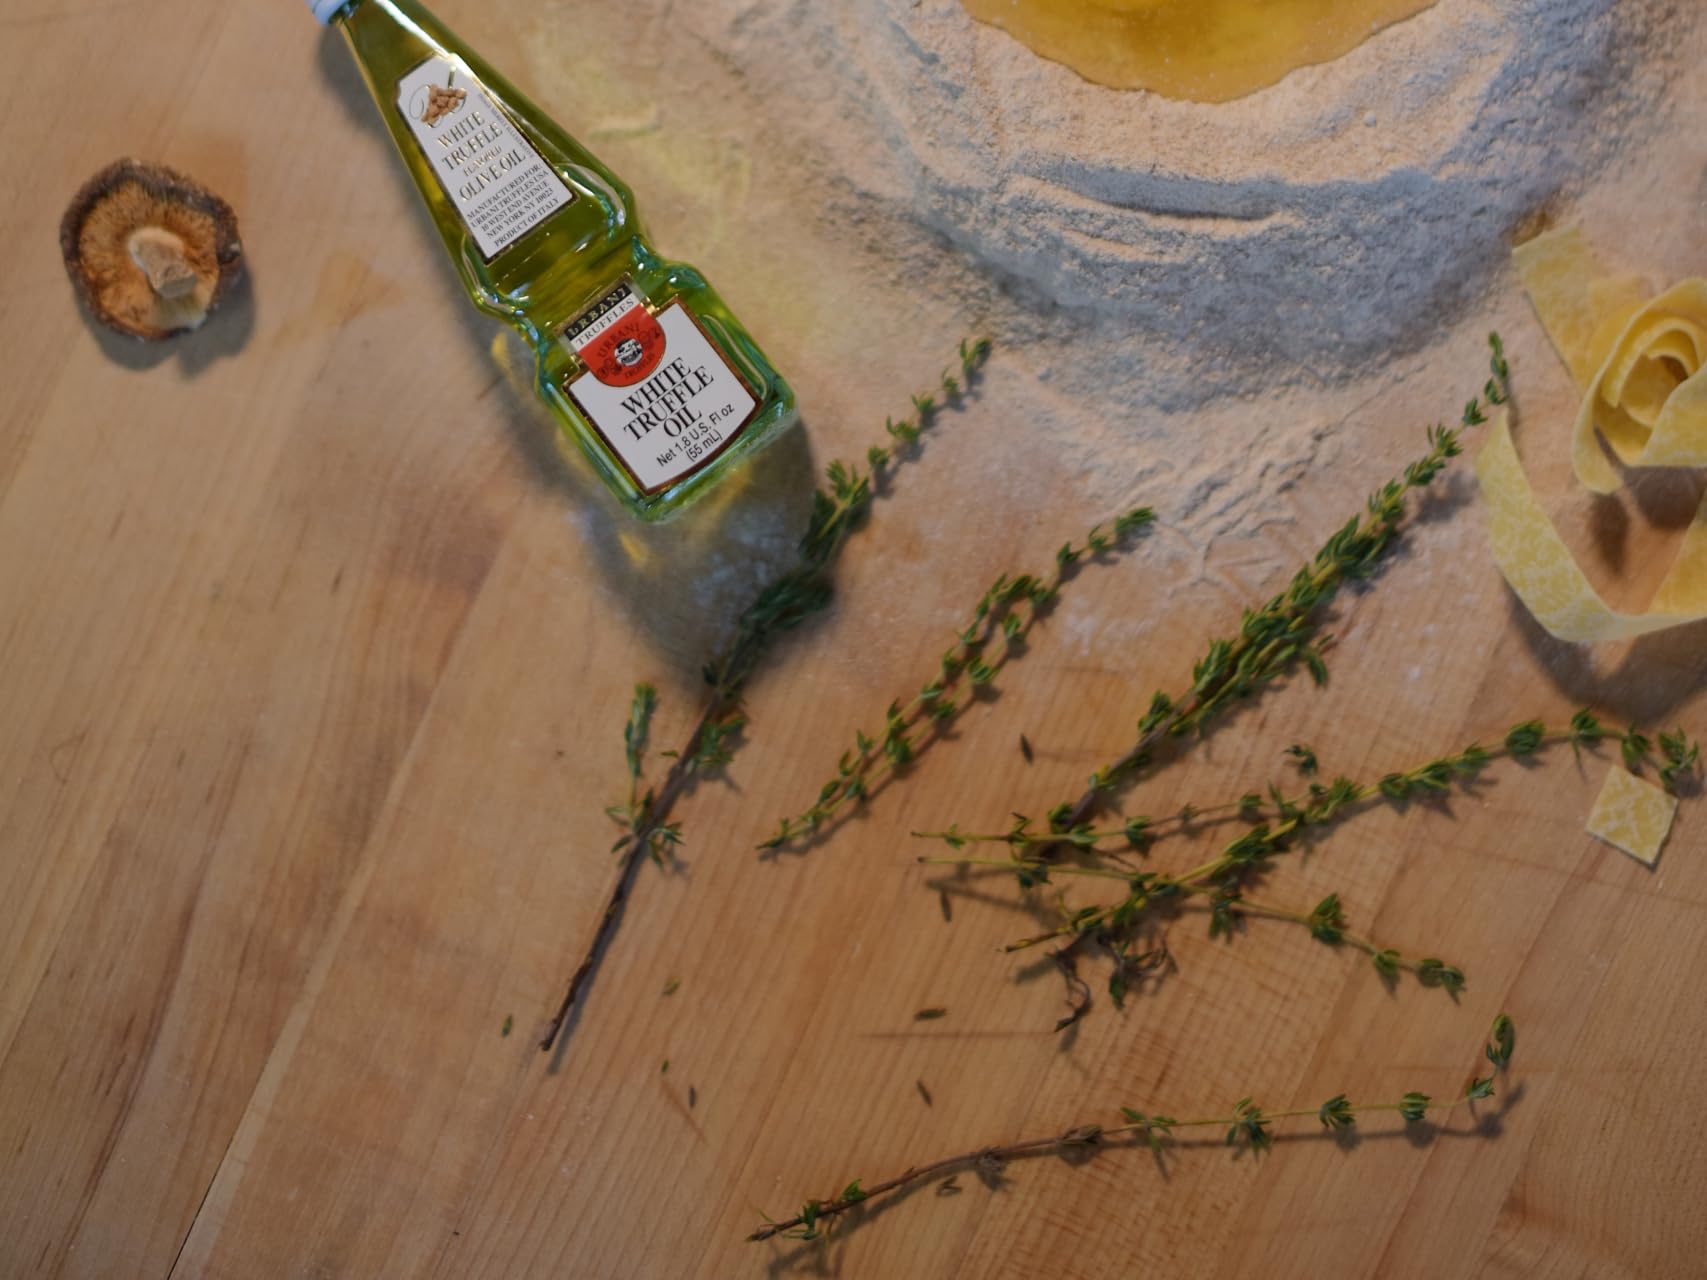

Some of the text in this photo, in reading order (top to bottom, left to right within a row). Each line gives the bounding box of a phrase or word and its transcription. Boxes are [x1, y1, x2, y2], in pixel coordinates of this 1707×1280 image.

[437, 111, 485, 149] WHITE
[442, 122, 502, 170] TRUFFLE
[459, 149, 526, 201] OLIVE OIL
[466, 173, 525, 219] MANUFACTURED
[471, 203, 501, 228] URBANI
[499, 178, 533, 210] TRUFFLES
[486, 224, 504, 239] NEW
[504, 209, 526, 227] YORK
[488, 211, 508, 227] WEST
[507, 199, 523, 214] END
[521, 181, 549, 203] AVENUE
[494, 197, 559, 247] PRODUCT OF ITALY
[576, 298, 634, 346] TRUFFLES
[621, 357, 692, 416] WHITE
[623, 365, 715, 441] TRUFFLE
[656, 403, 735, 467] Net 1.8 U.S. Fl oz
[663, 406, 703, 438] OIL
[686, 428, 724, 462] (55 mL)
